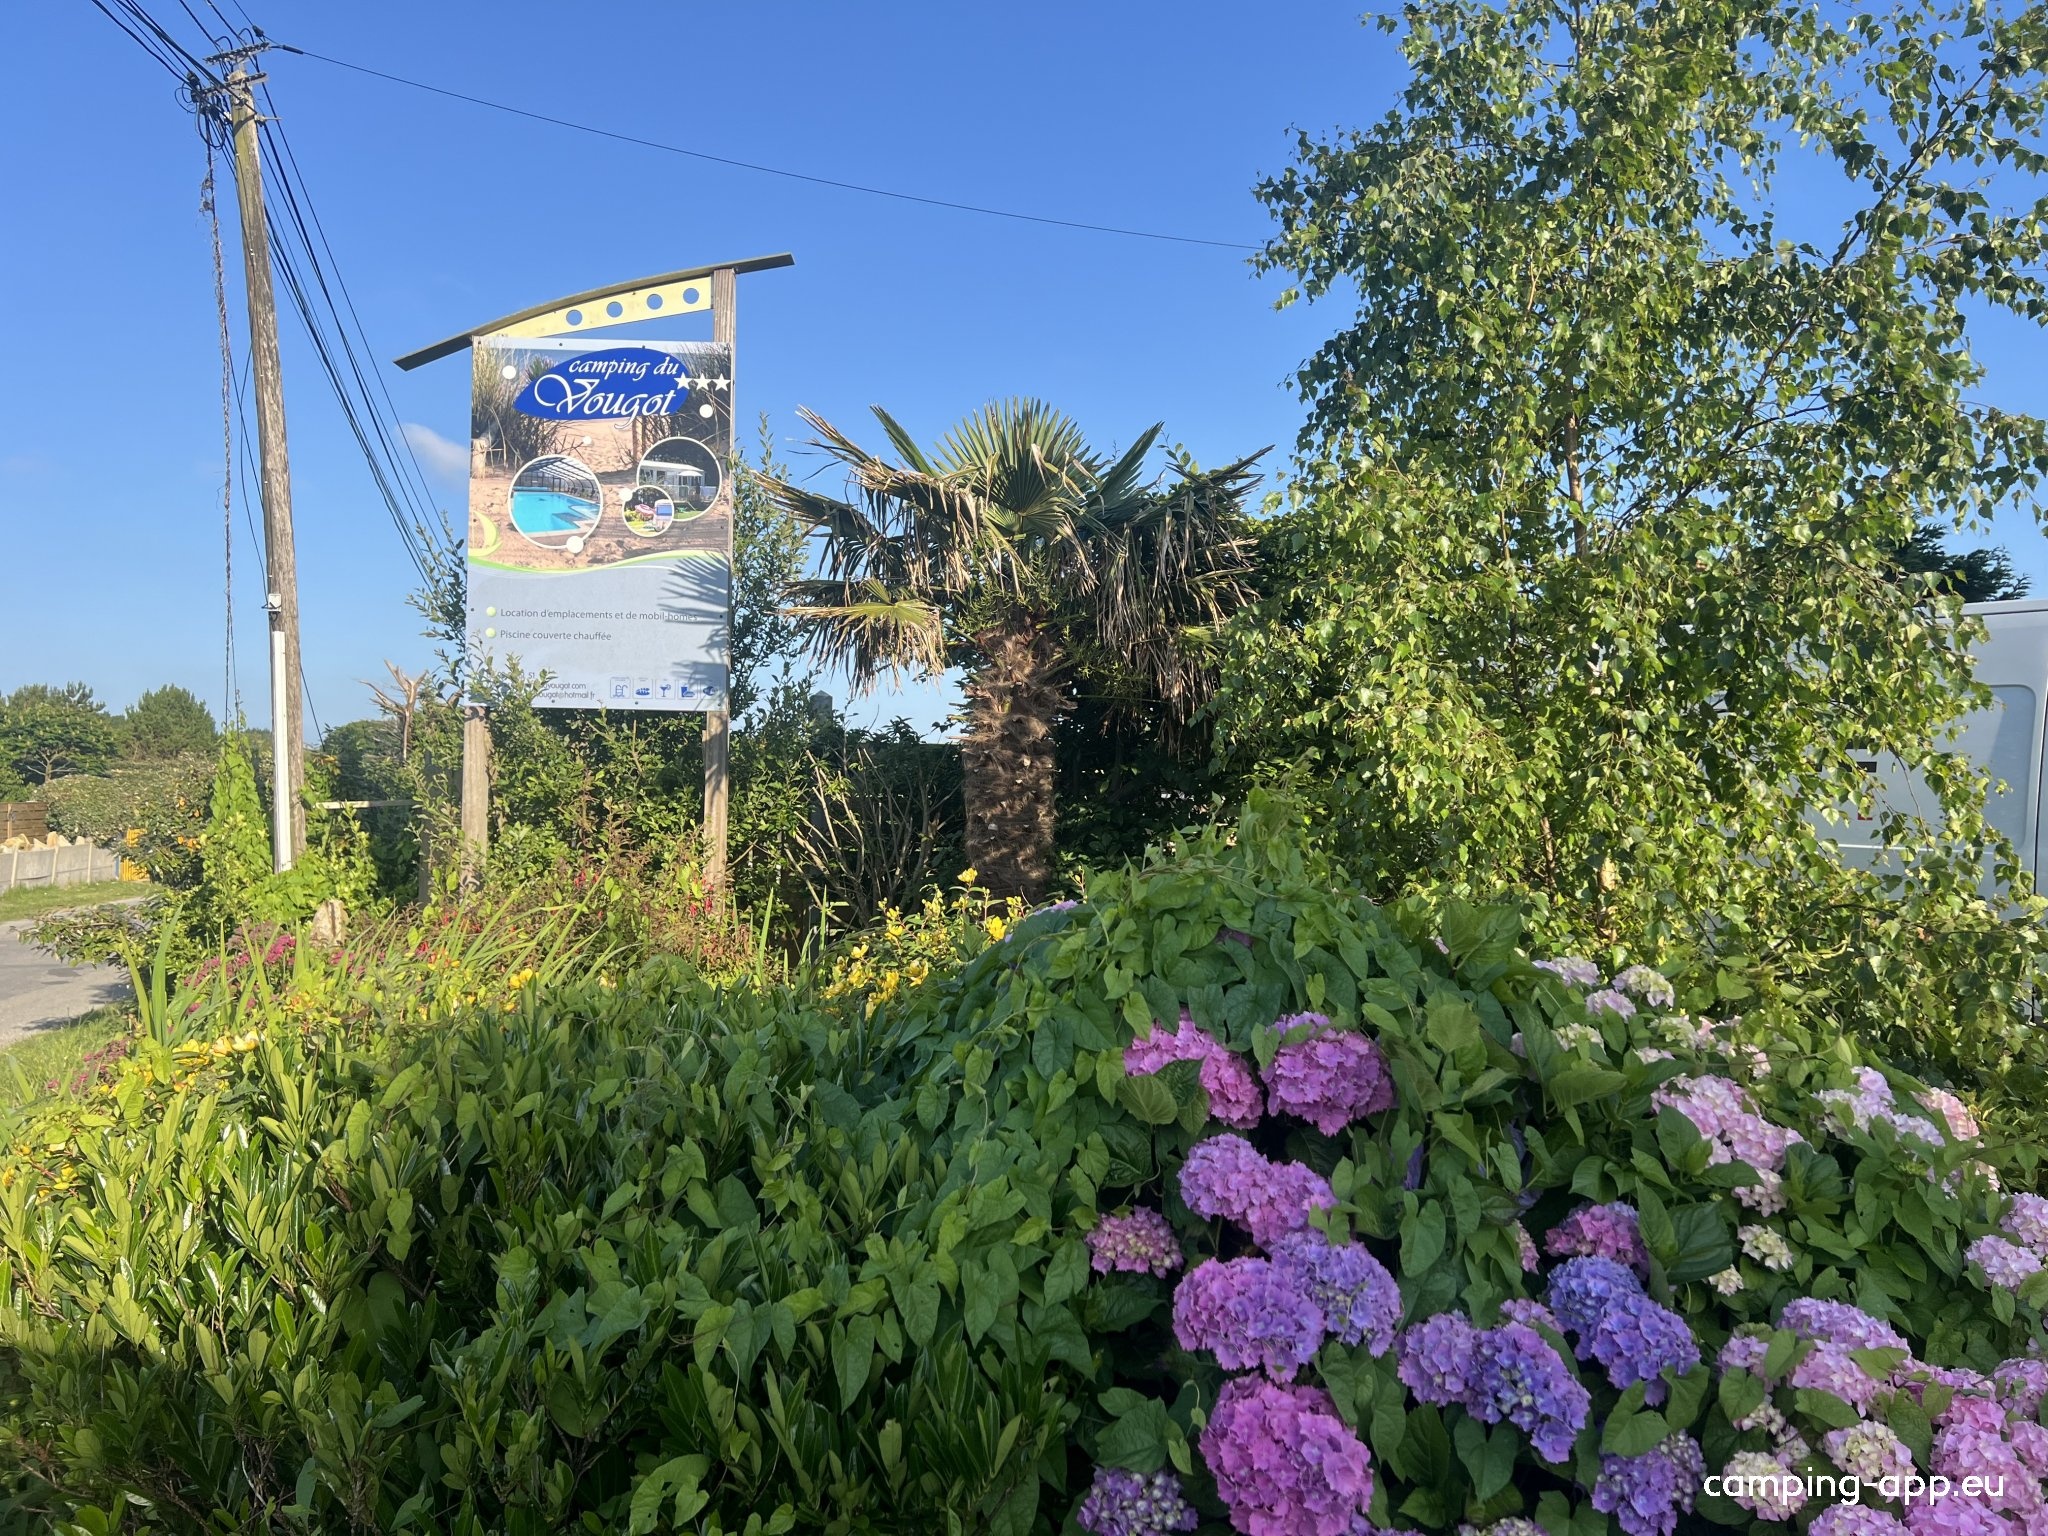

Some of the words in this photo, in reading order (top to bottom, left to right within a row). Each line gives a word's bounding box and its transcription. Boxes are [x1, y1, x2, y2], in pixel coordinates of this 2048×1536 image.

[569, 358, 651, 381] camping
[653, 356, 679, 375] du
[534, 374, 677, 429] Vougot
[500, 608, 539, 618] Location
[540, 609, 613, 620] d'emplacements
[615, 611, 624, 620] et
[625, 611, 637, 620] de
[639, 611, 698, 621] mobil-homes
[500, 629, 531, 639] Piscine
[532, 631, 572, 640] couverte
[573, 631, 612, 641] chauffée
